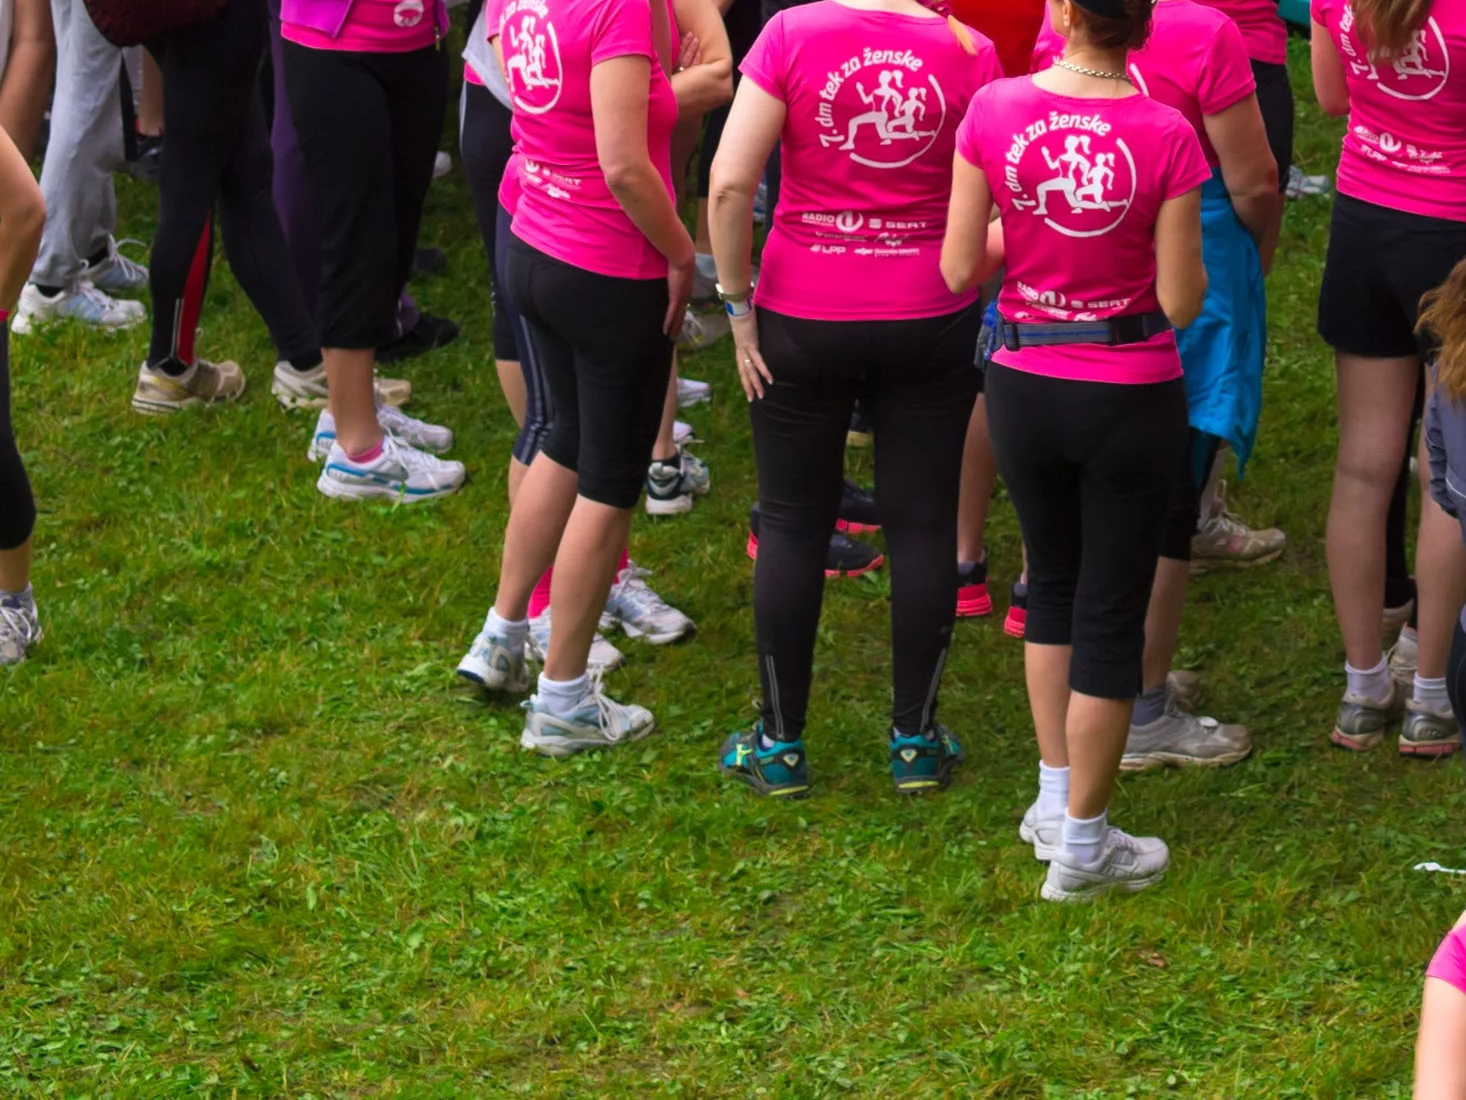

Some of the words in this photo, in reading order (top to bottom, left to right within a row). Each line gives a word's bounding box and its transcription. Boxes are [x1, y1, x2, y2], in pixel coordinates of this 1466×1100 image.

[840, 56, 862, 78] za
[863, 47, 923, 72] ženske
[819, 71, 845, 101] tek
[815, 102, 834, 128] dm
[1049, 110, 1111, 136] ženske
[1025, 119, 1047, 142] za
[1005, 134, 1029, 165] tek
[1004, 165, 1023, 192] dm
